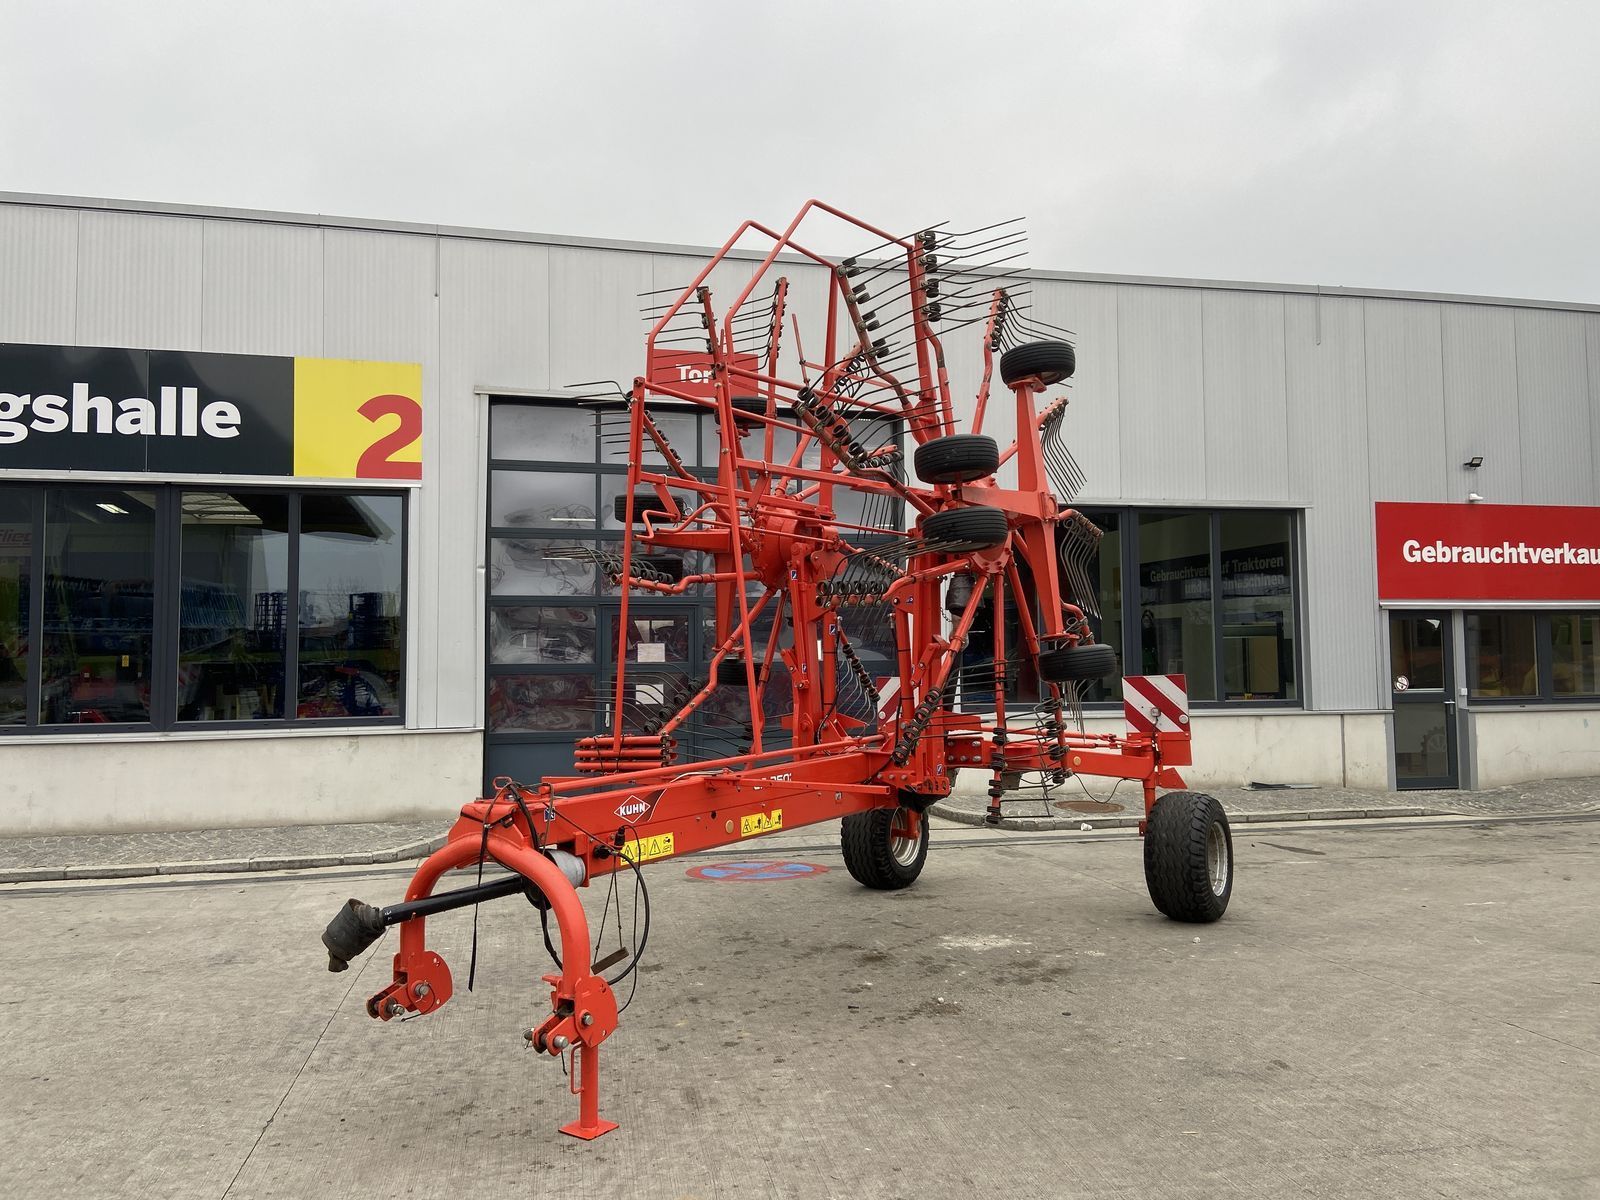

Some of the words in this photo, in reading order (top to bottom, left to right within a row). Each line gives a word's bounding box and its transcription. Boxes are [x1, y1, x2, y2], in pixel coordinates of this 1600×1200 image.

[0, 382, 242, 444] gshalle
[355, 394, 423, 480] 2
[1402, 539, 1600, 565] Gebrauchtverkau
[1150, 562, 1229, 582] Gebrauchtverf
[1232, 556, 1284, 572] Traktoren
[619, 802, 646, 817] KUHN
